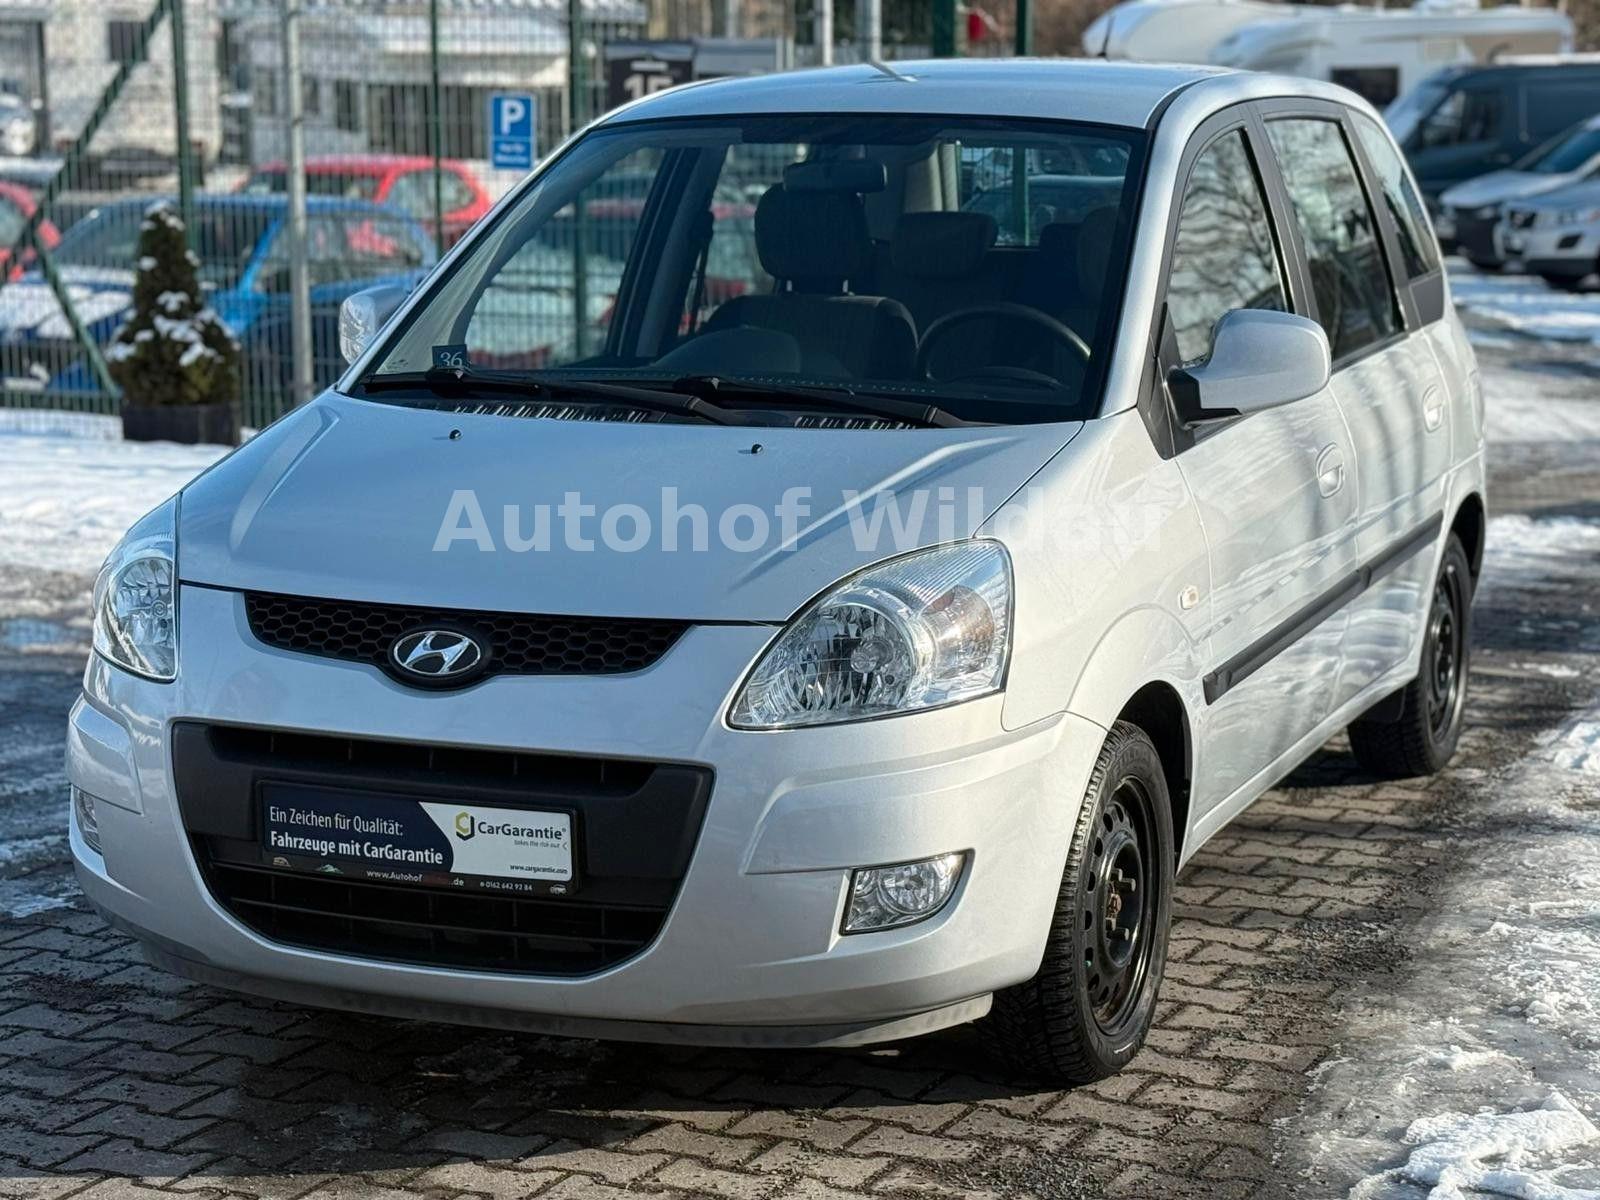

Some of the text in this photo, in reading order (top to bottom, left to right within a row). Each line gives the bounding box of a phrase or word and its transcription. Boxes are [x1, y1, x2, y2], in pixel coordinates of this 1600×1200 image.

[502, 99, 525, 135] P
[440, 351, 463, 368] 36
[269, 806, 404, 836] Ein Zeichen für Qualität:
[270, 831, 444, 865] Fahrzeuge mit CarGarantie
[510, 864, 568, 874] www.cargarantie.com
[485, 880, 500, 889] 0162
